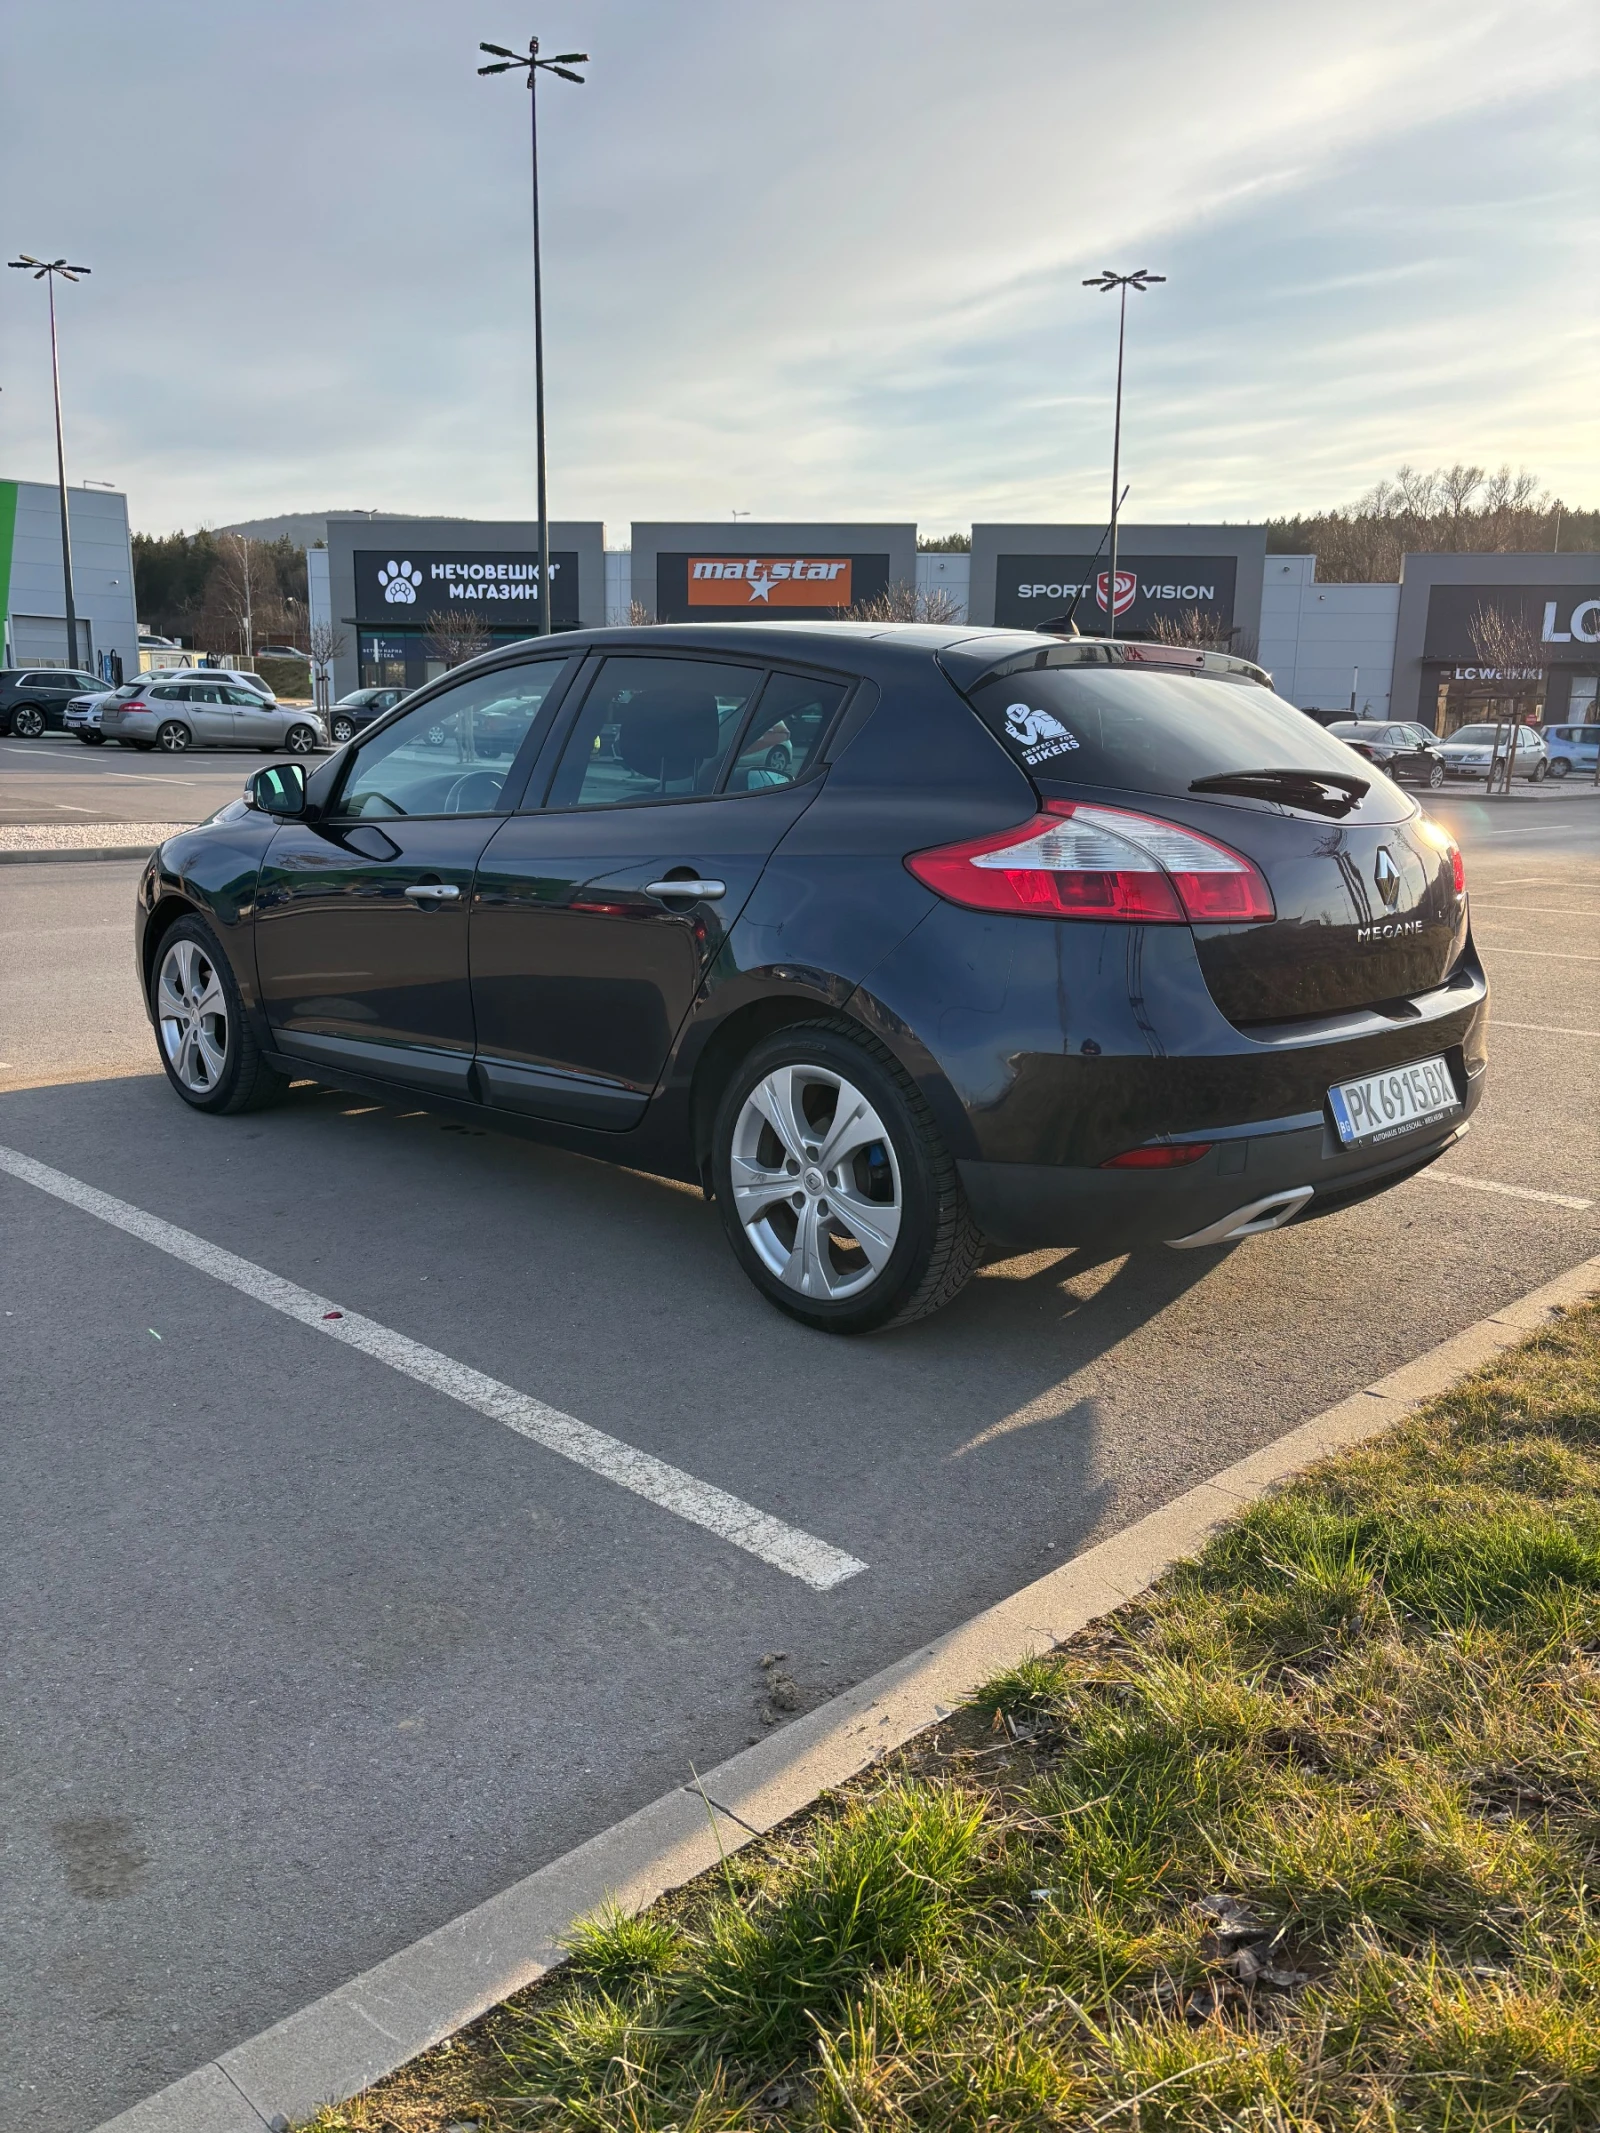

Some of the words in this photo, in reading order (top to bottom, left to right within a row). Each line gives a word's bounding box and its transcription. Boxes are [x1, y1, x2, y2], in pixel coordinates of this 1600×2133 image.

[692, 559, 762, 579] mat
[770, 560, 846, 580] star
[449, 583, 538, 600] МАГАЗИН
[1017, 584, 1092, 598] SPORT
[1141, 585, 1215, 600] VISION
[1455, 667, 1477, 680] LC
[1021, 740, 1055, 757] RESPECT
[1059, 734, 1075, 742] FOR
[1025, 739, 1080, 765] BIKERS
[1357, 920, 1424, 943] MEGANE
[1340, 1119, 1351, 1134] BG
[1372, 1128, 1398, 1143] AUTOHAUS
